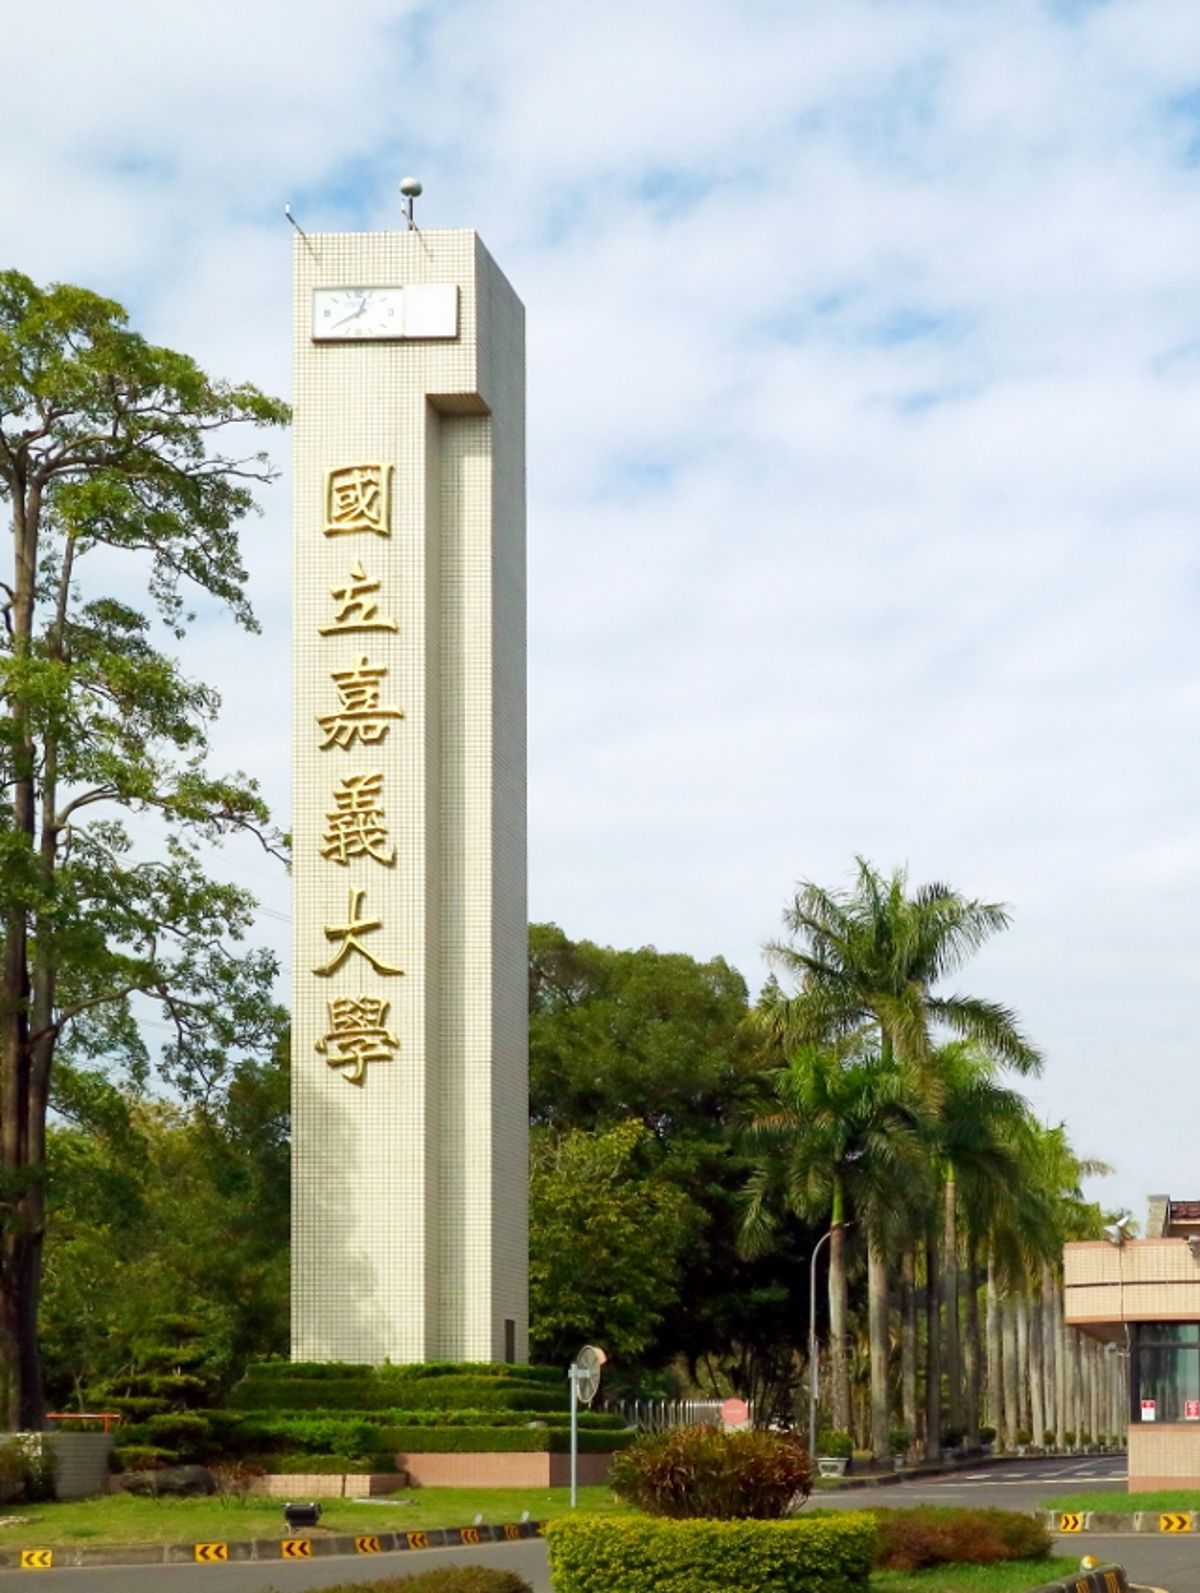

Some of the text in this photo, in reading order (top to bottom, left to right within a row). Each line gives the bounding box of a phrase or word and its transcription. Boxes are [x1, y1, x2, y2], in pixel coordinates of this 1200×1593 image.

[312, 462, 404, 1086] 國立嘉義大學
